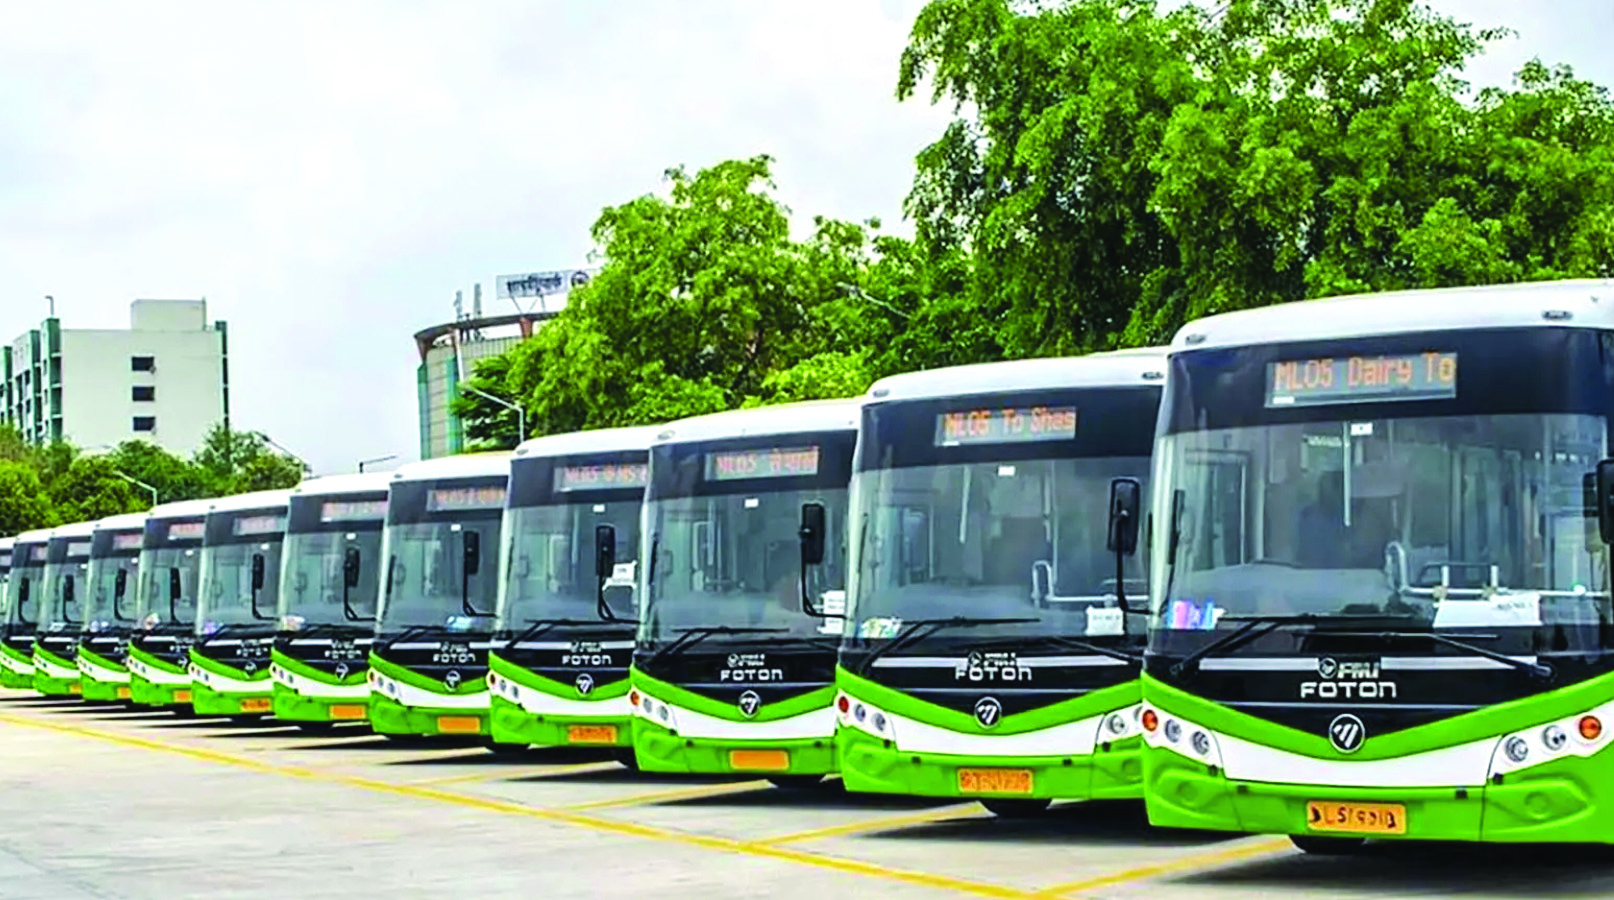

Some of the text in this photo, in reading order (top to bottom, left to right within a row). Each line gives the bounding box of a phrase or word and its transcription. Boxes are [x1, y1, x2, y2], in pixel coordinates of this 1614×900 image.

[1349, 357, 1412, 386] Dairy
[720, 669, 783, 681] FOTON
[955, 666, 1032, 681] FOTON
[1300, 682, 1396, 698] FOTON
